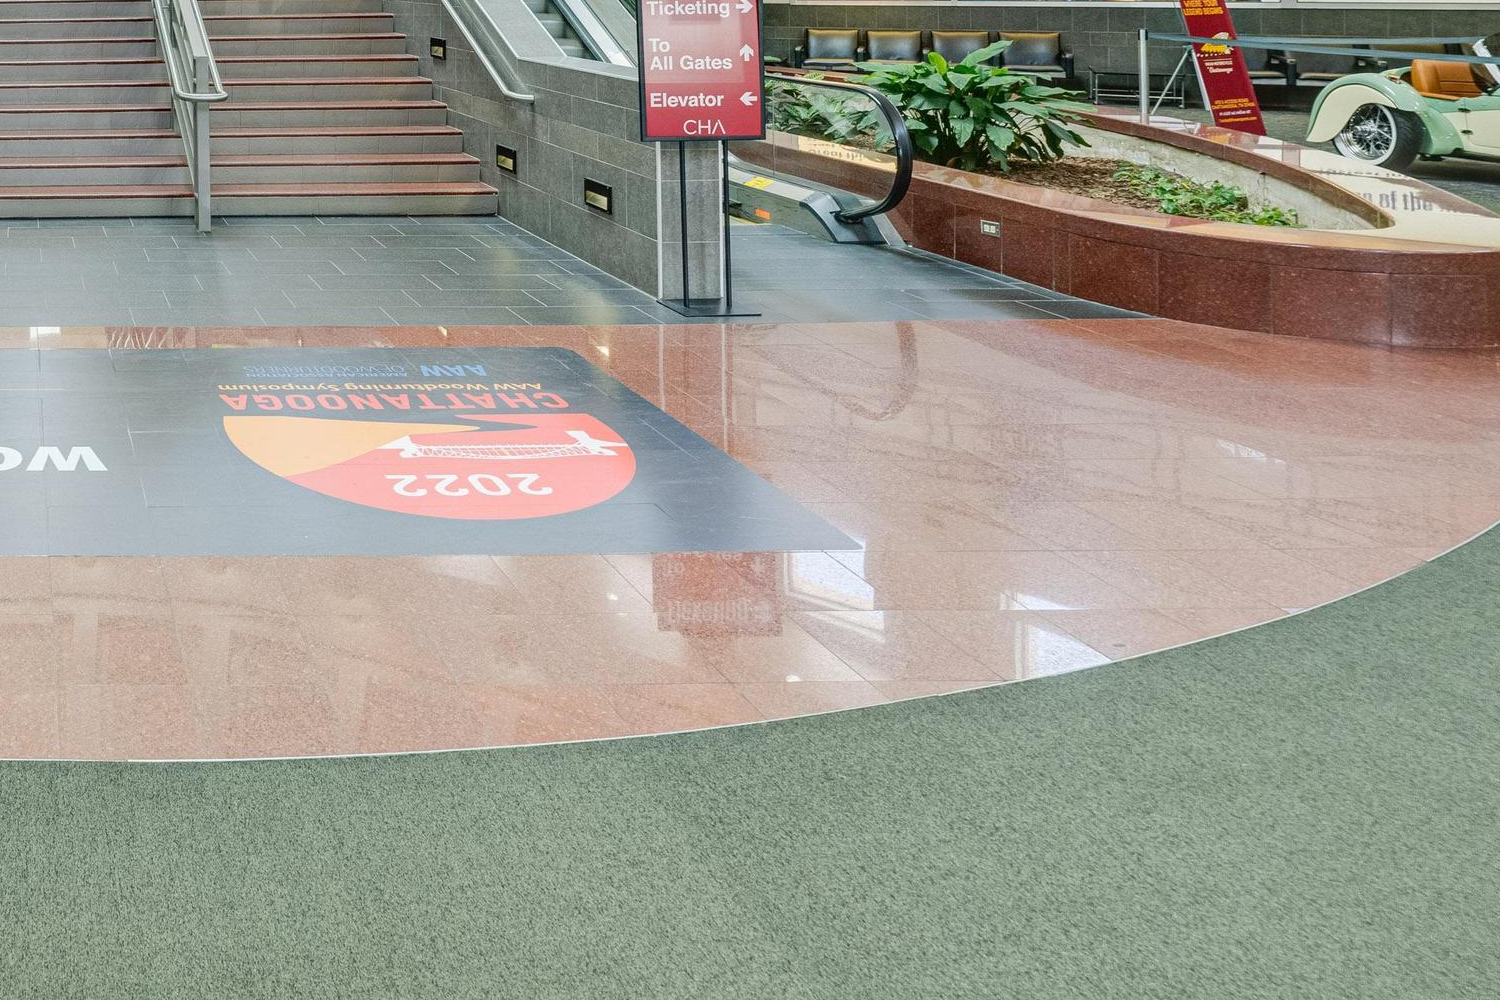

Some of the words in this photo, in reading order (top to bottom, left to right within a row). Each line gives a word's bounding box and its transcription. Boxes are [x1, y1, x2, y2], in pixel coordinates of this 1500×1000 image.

[646, 1, 731, 18] Ticketing
[648, 38, 670, 53] To
[650, 55, 673, 71] All
[679, 55, 733, 70] Gates
[650, 92, 725, 108] Elevator
[683, 119, 726, 135] CHA
[419, 363, 487, 377] AAW
[217, 382, 340, 392] Symposium
[344, 381, 490, 392] Woodturning
[492, 382, 542, 391] AAW
[219, 391, 571, 413] CHATTANOOGA
[383, 471, 554, 499] 2022
